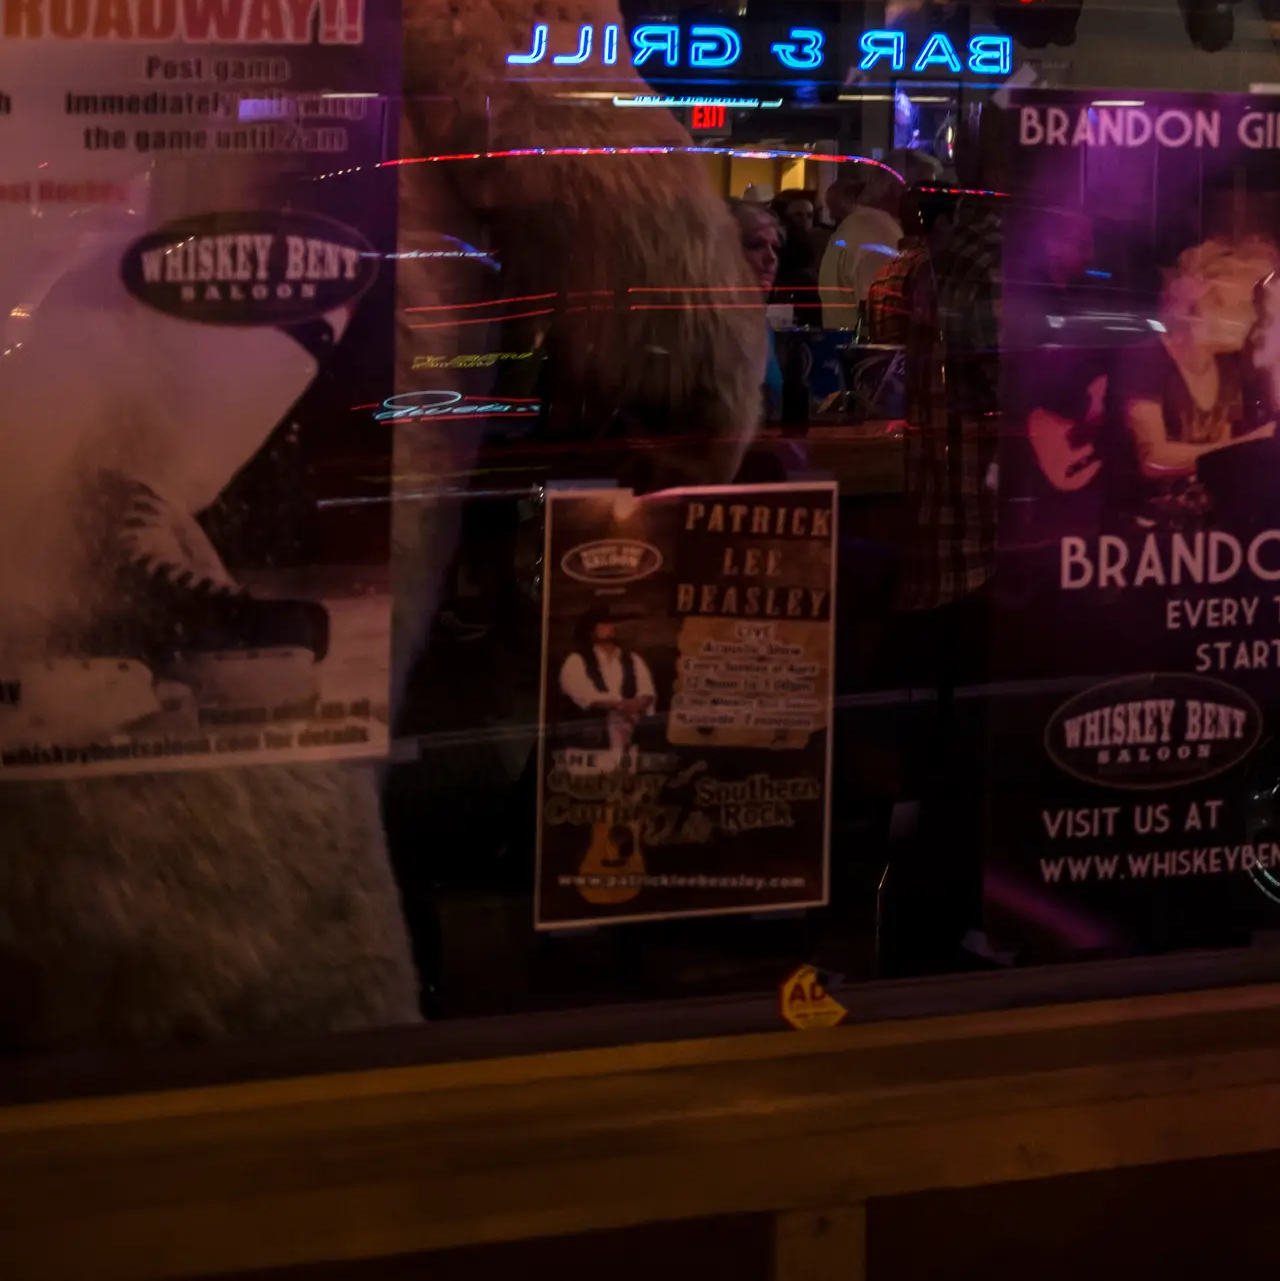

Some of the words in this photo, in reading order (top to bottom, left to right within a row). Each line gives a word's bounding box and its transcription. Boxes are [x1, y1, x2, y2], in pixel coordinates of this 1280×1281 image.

[691, 105, 726, 129] EXIT
[1020, 106, 1221, 149] BRANDON
[141, 233, 273, 285] WHISKEY
[285, 235, 360, 281] BENT
[181, 281, 318, 301] SALOON
[684, 502, 831, 537] PATRICK
[722, 547, 783, 578] LEE
[676, 584, 830, 618] BEASLEY
[1167, 596, 1259, 630] EVERY
[1063, 698, 1176, 749] WHISKEY
[1184, 698, 1248, 741] BENT
[1096, 743, 1212, 765] SALOON
[1043, 807, 1121, 839] VISIT
[1134, 804, 1170, 835] US
[1185, 800, 1223, 831] AT
